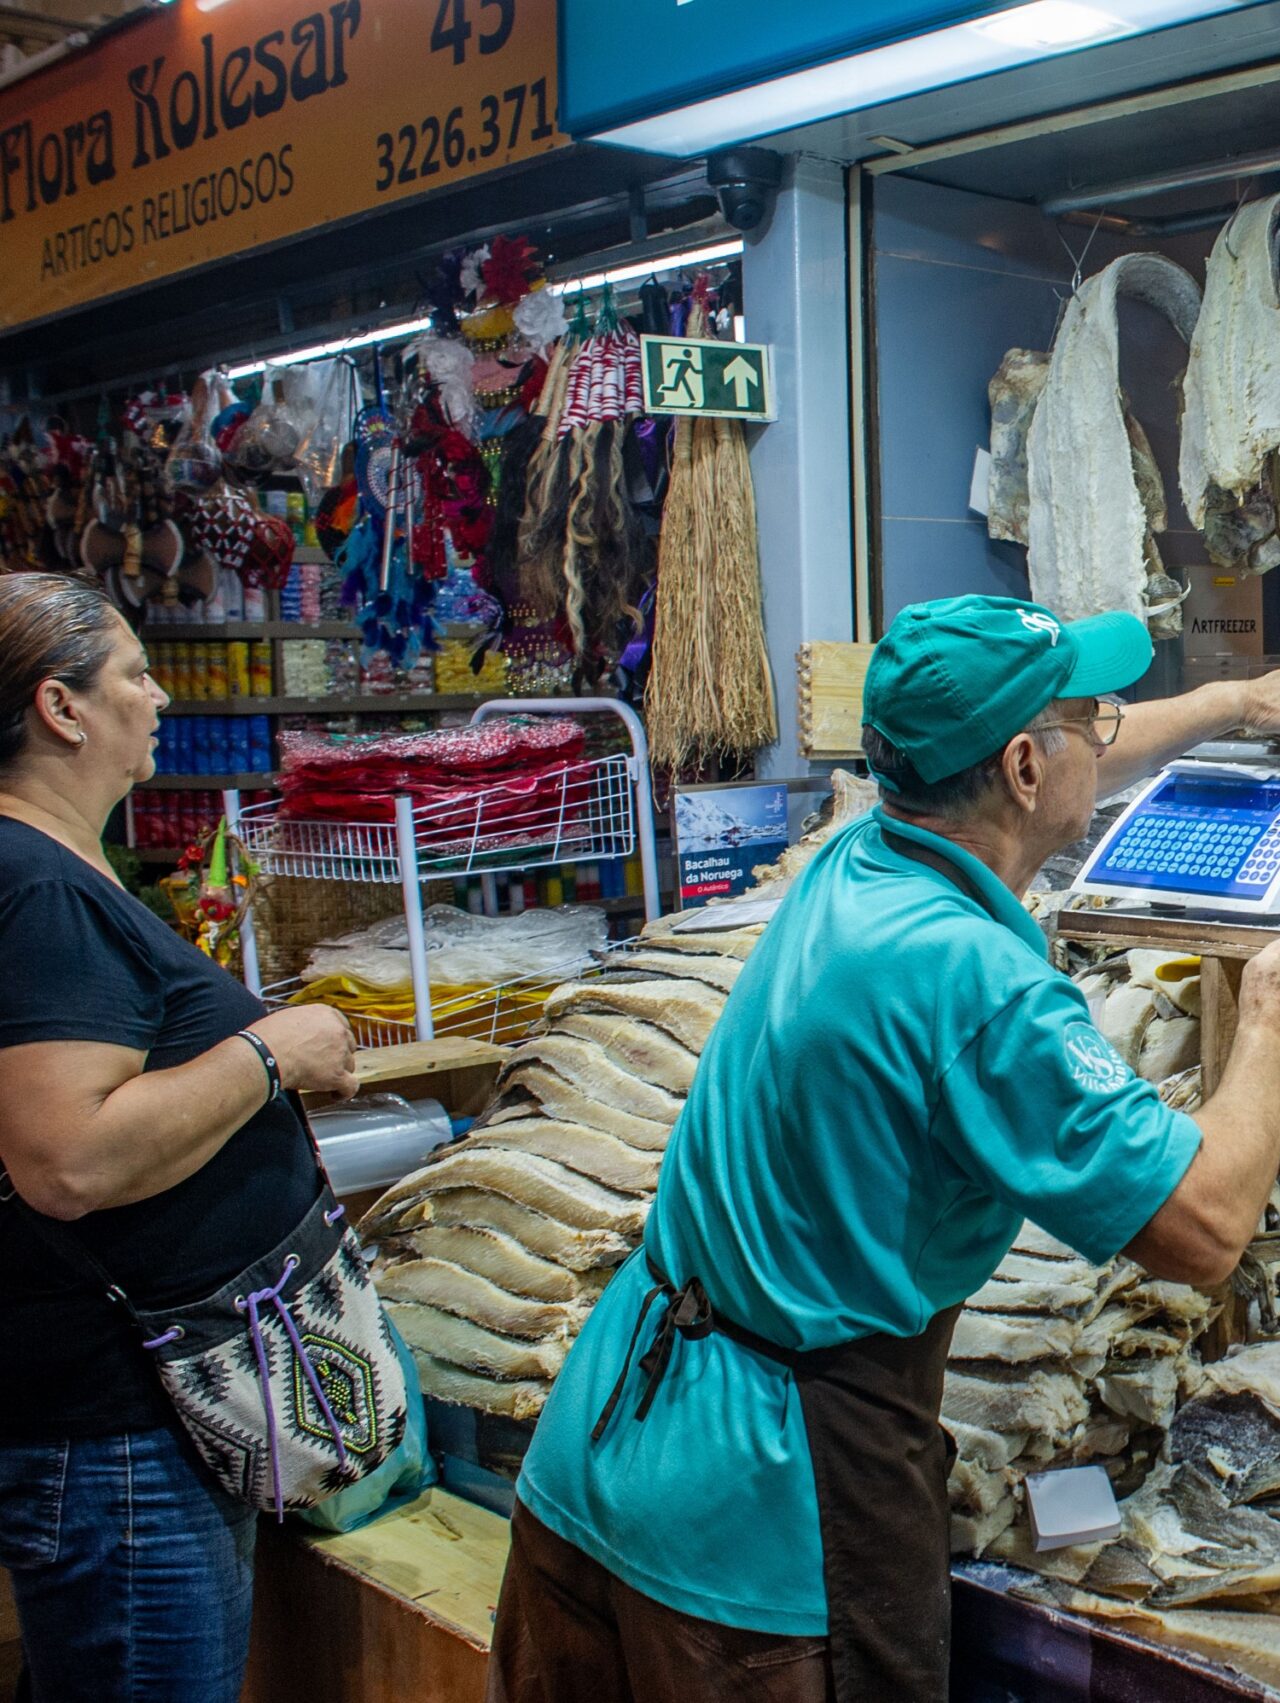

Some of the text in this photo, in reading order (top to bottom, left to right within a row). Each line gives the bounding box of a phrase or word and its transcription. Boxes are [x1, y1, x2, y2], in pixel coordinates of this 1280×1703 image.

[0, 0, 361, 224] Flora Kolesar
[376, 76, 558, 192] 3226.371
[41, 144, 294, 282] ARTIGOS RELIGIOSOS
[1191, 617, 1257, 634] ARTFREEZER
[684, 857, 730, 871] Bacalhau
[686, 868, 743, 884] da Noruega
